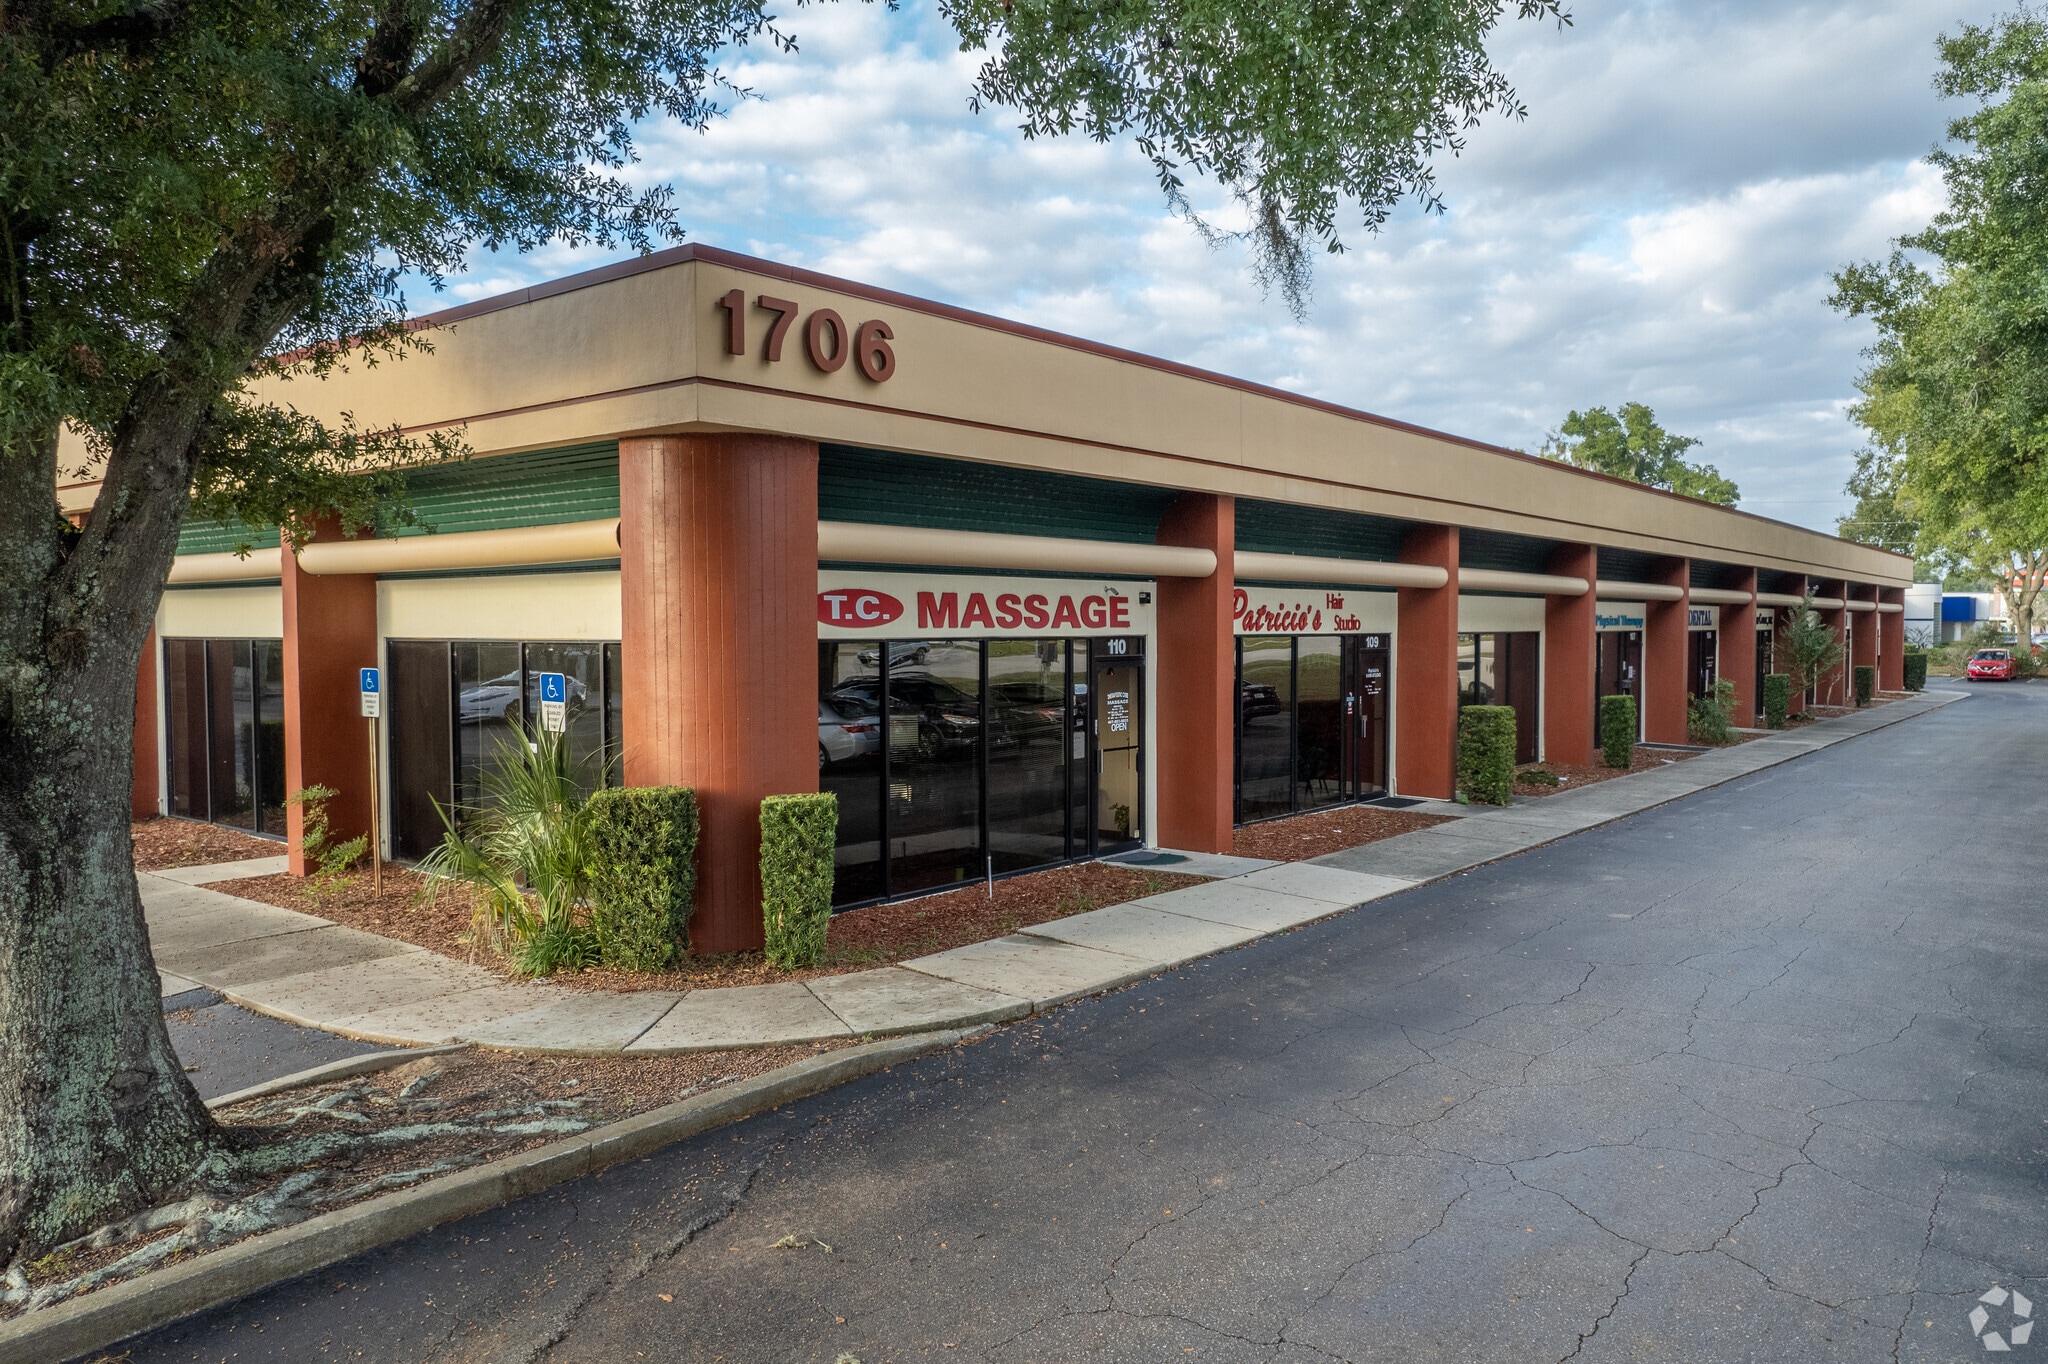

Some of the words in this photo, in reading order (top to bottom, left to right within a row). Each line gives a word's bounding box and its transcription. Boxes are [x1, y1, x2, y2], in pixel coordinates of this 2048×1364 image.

[719, 288, 896, 383] 1706
[1326, 593, 1344, 609] Hair
[824, 595, 890, 620] T.C.
[917, 591, 1131, 629] MASSAGE
[1689, 610, 1712, 626] DENTAL
[1334, 614, 1361, 631] Studio
[1108, 639, 1126, 655] 110
[1366, 636, 1379, 648] 109
[1111, 722, 1127, 731] OPEN
